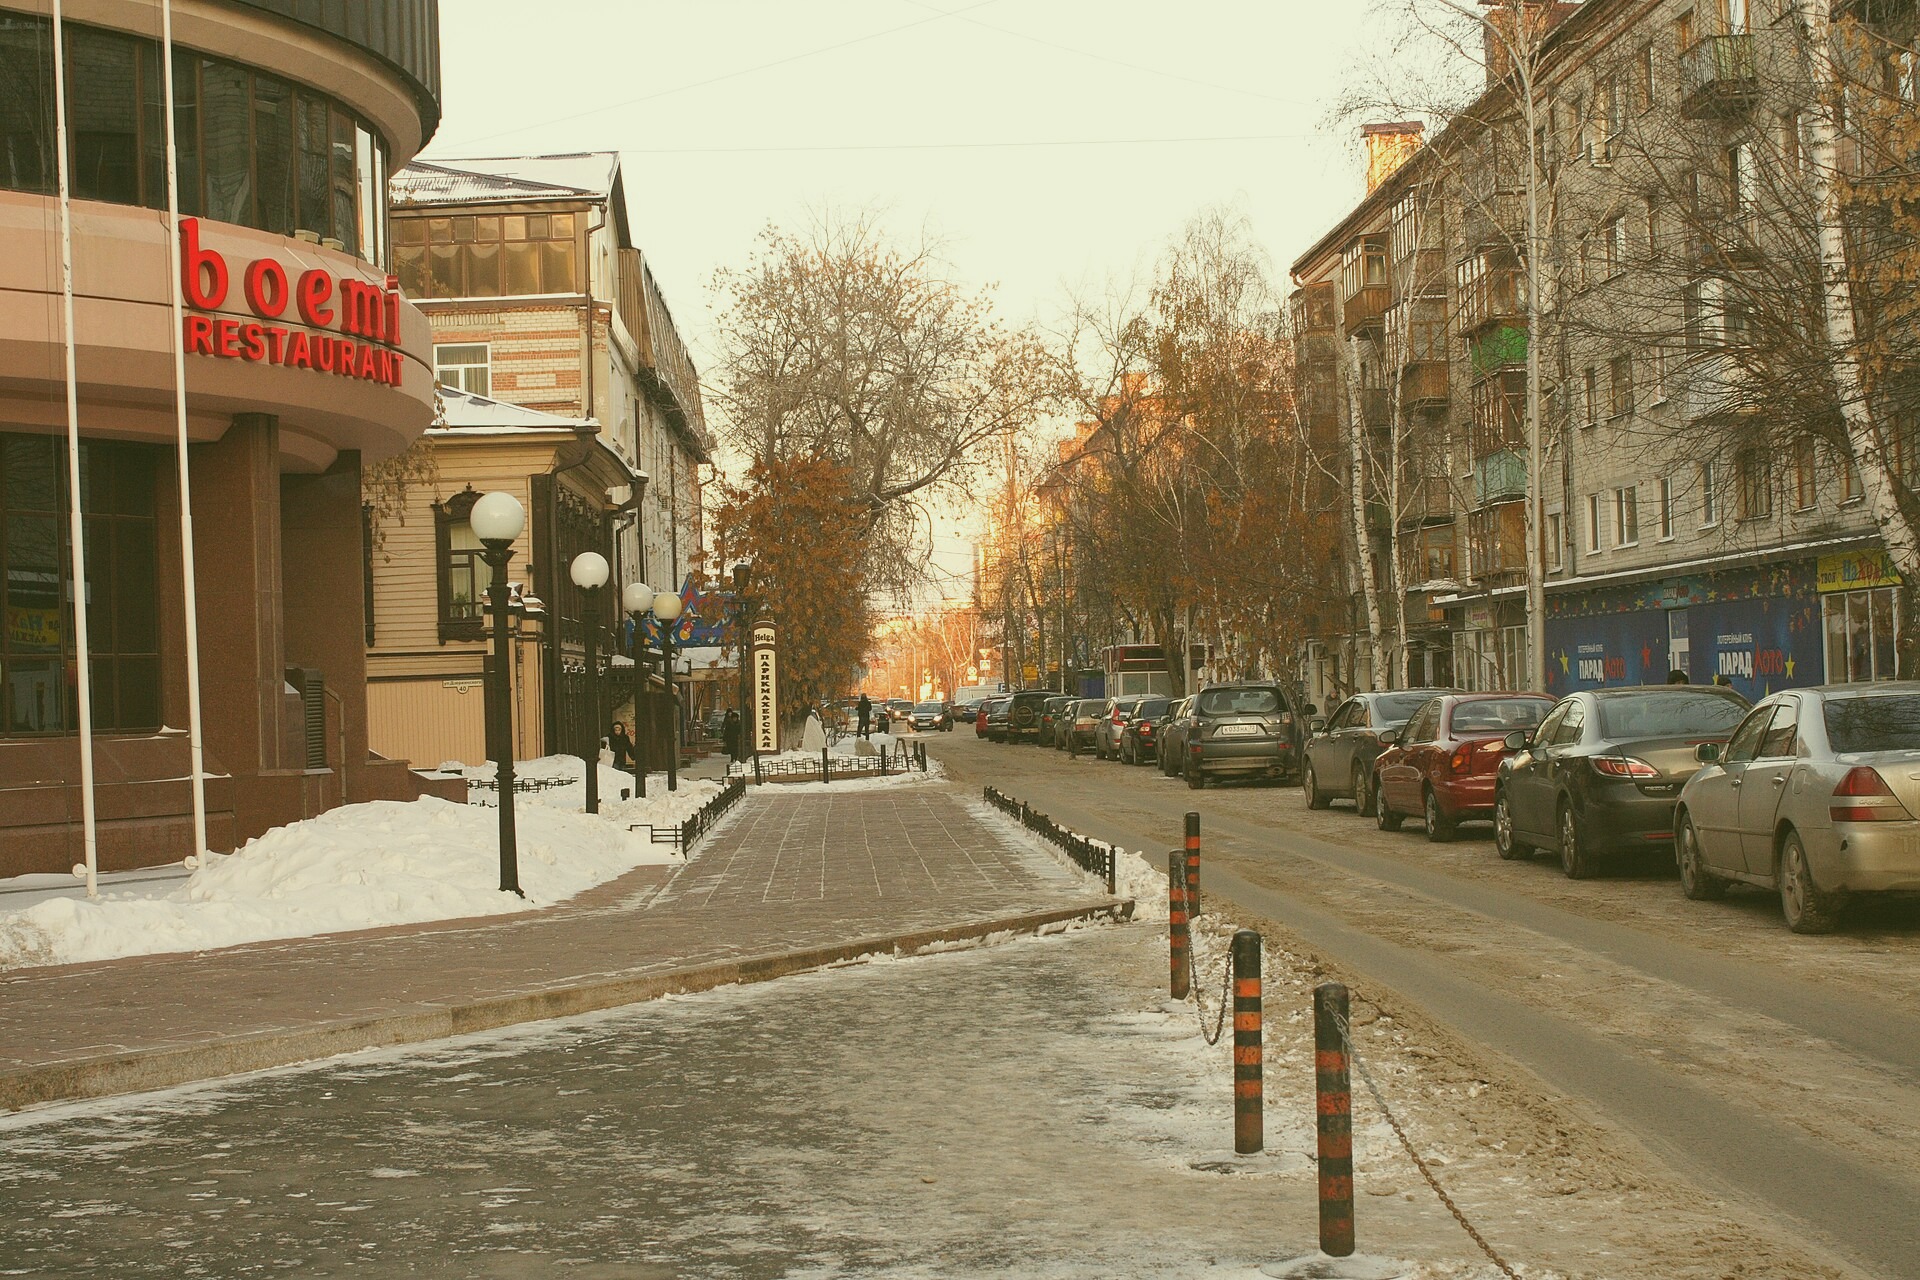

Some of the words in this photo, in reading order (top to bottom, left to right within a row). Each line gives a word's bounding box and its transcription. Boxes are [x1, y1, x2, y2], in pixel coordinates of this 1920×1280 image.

[178, 217, 401, 345] boemi
[183, 315, 404, 387] RESTAURANT
[754, 633, 775, 643] Helga
[1578, 659, 1604, 682] ПАРАД
[1718, 651, 1753, 679] ПАРАД
[760, 654, 771, 748] ПАРИКМАХЕРСКАЯ
